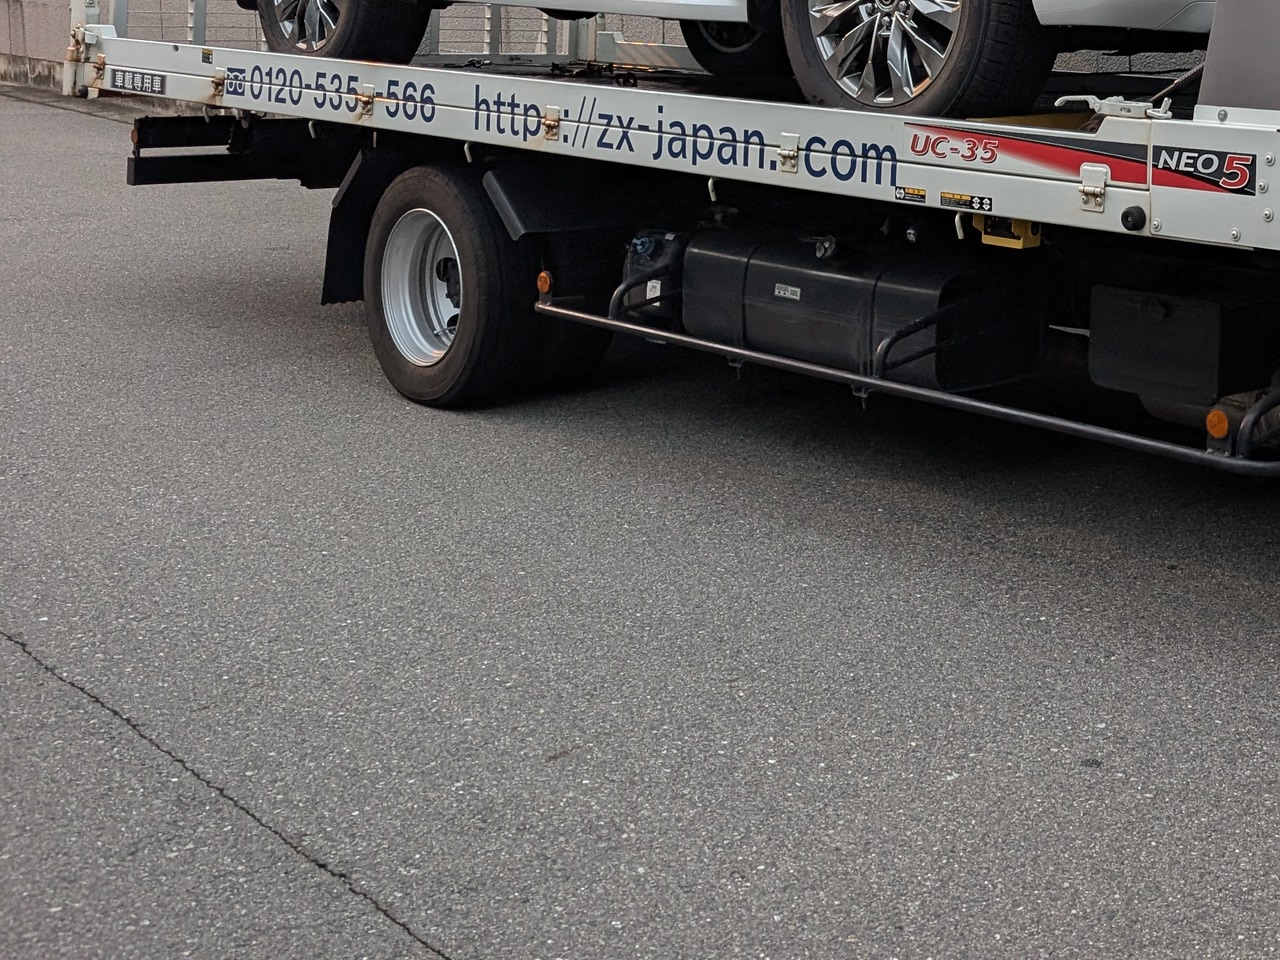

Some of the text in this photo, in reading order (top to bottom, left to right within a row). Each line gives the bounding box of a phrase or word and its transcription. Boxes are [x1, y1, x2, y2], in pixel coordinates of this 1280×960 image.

[114, 70, 162, 93] 車載専用車
[909, 132, 1000, 164] UC-35
